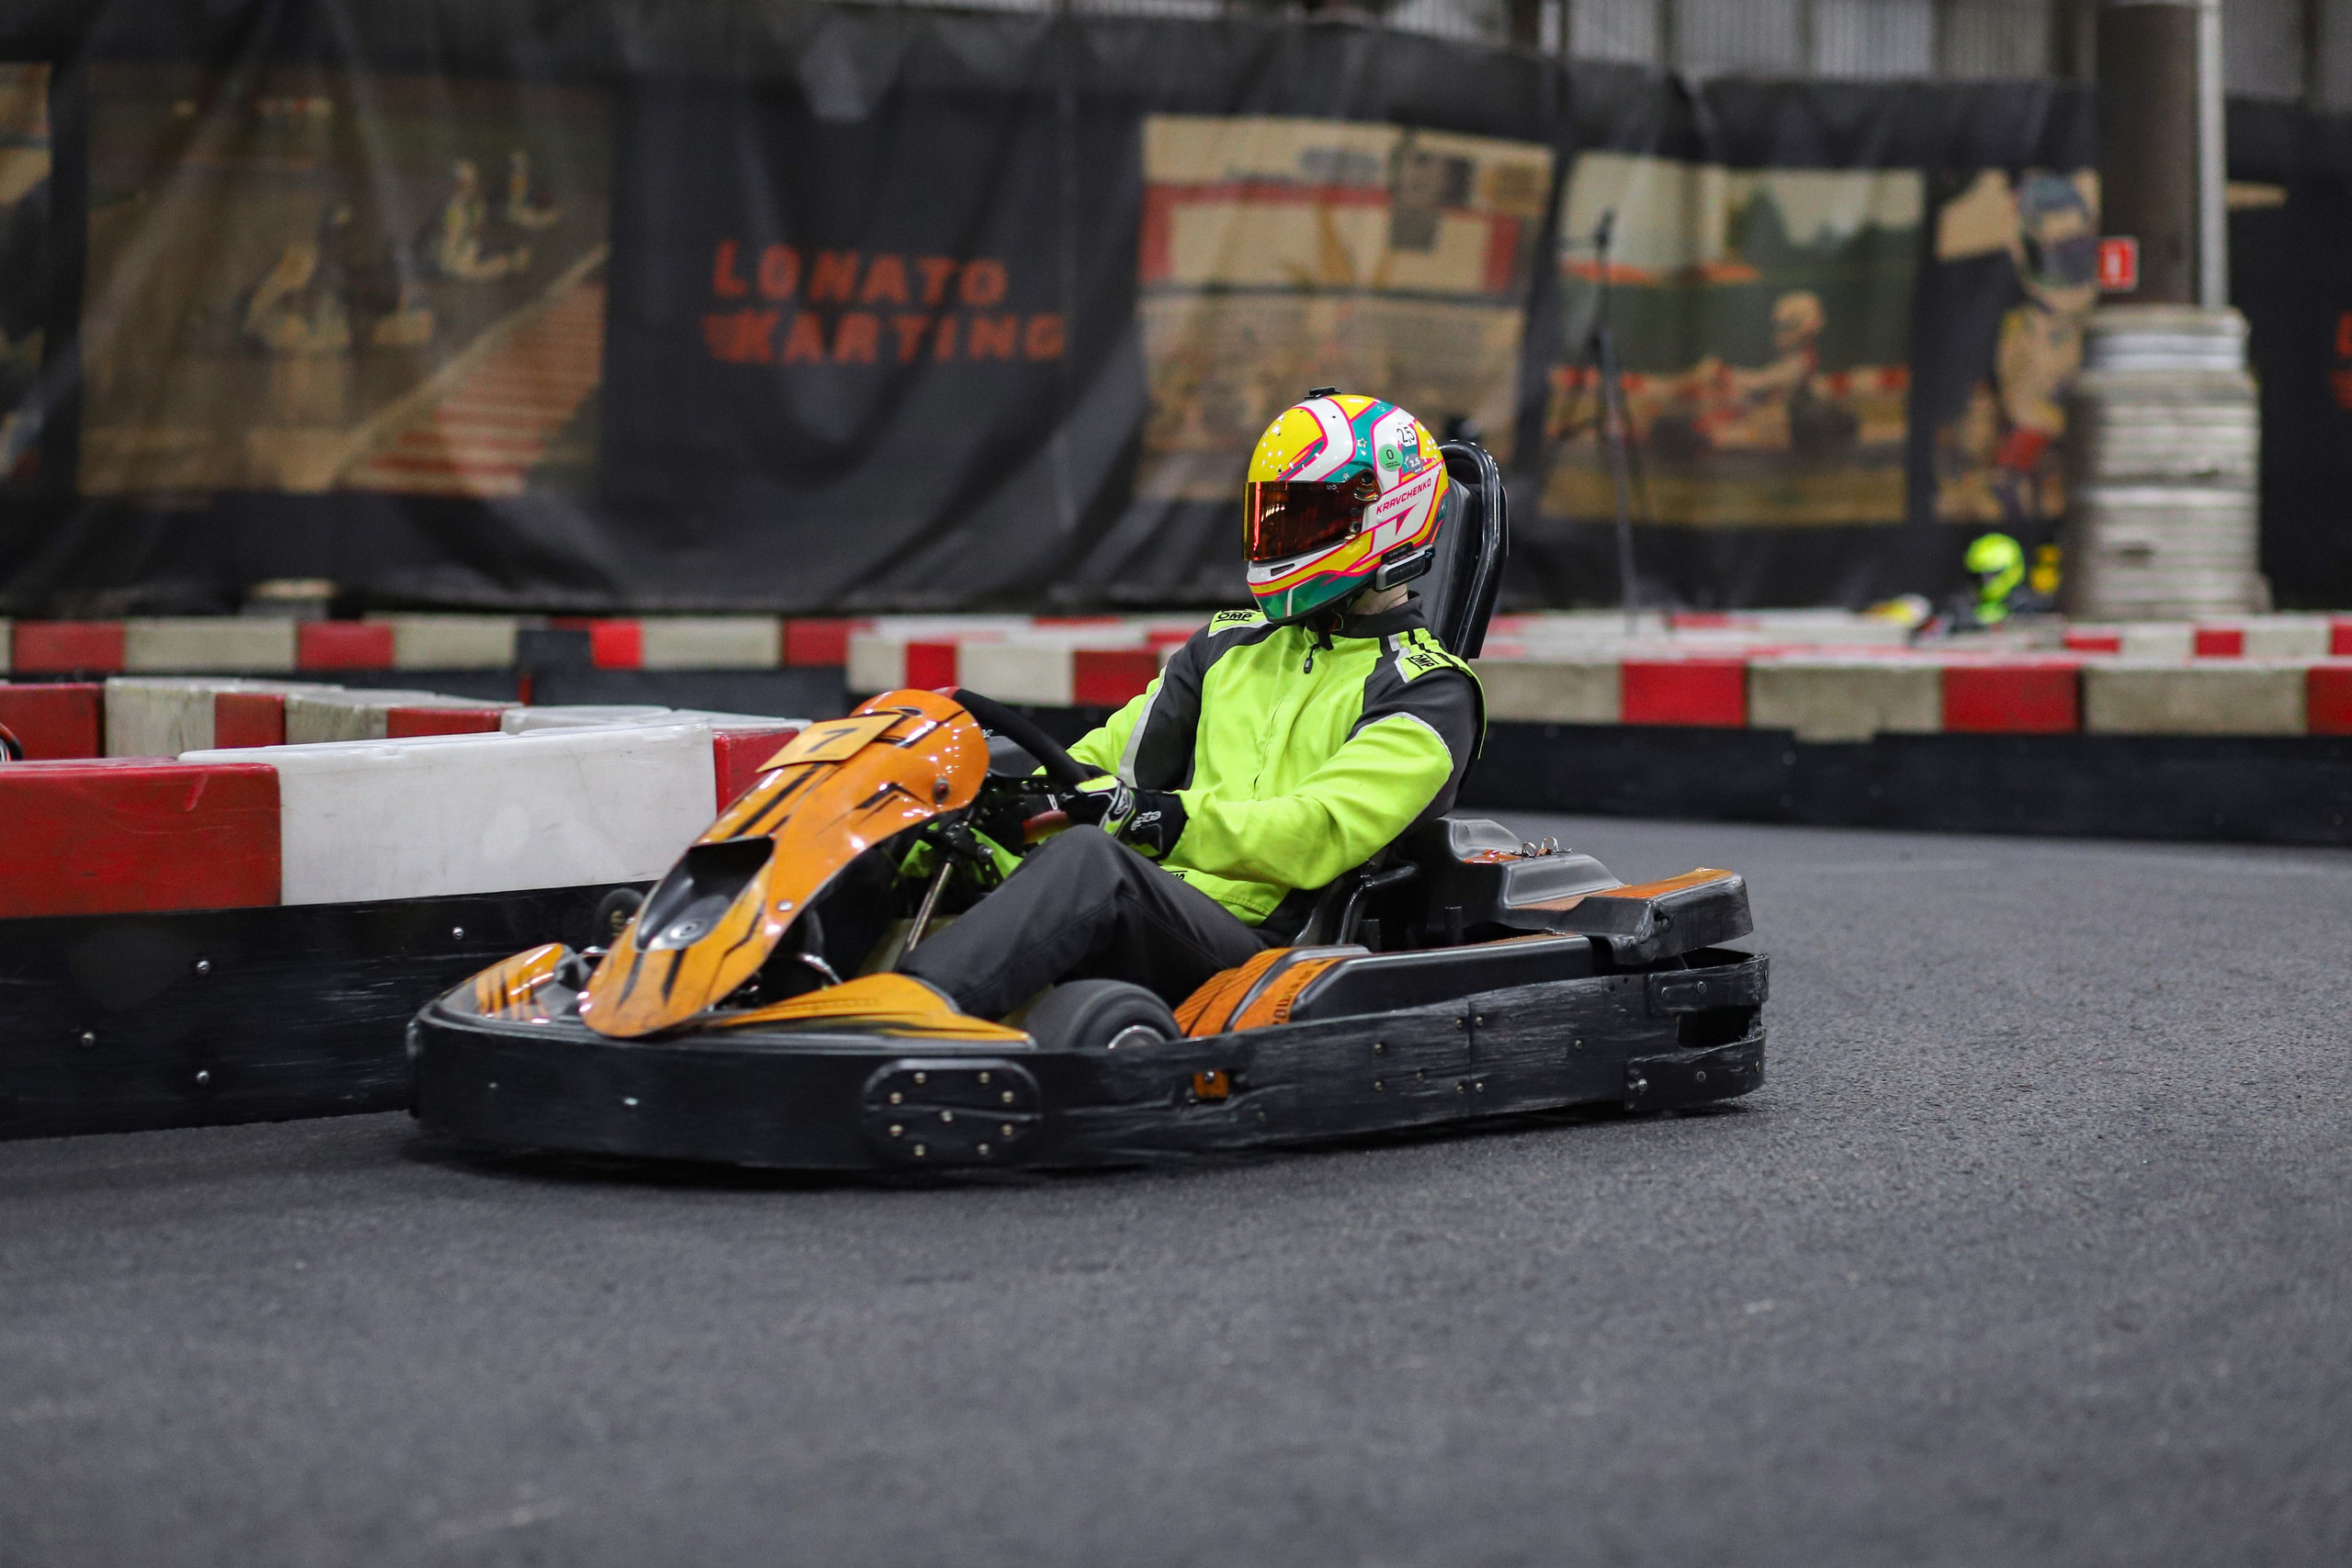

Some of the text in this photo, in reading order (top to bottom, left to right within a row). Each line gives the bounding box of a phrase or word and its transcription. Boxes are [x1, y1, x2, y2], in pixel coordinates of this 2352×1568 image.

[713, 241, 1009, 306] LONATO
[726, 309, 1066, 364] KARTING
[1376, 478, 1431, 514] KRAVCHENKO
[1217, 612, 1253, 621] OMP
[1408, 653, 1437, 669] OMP
